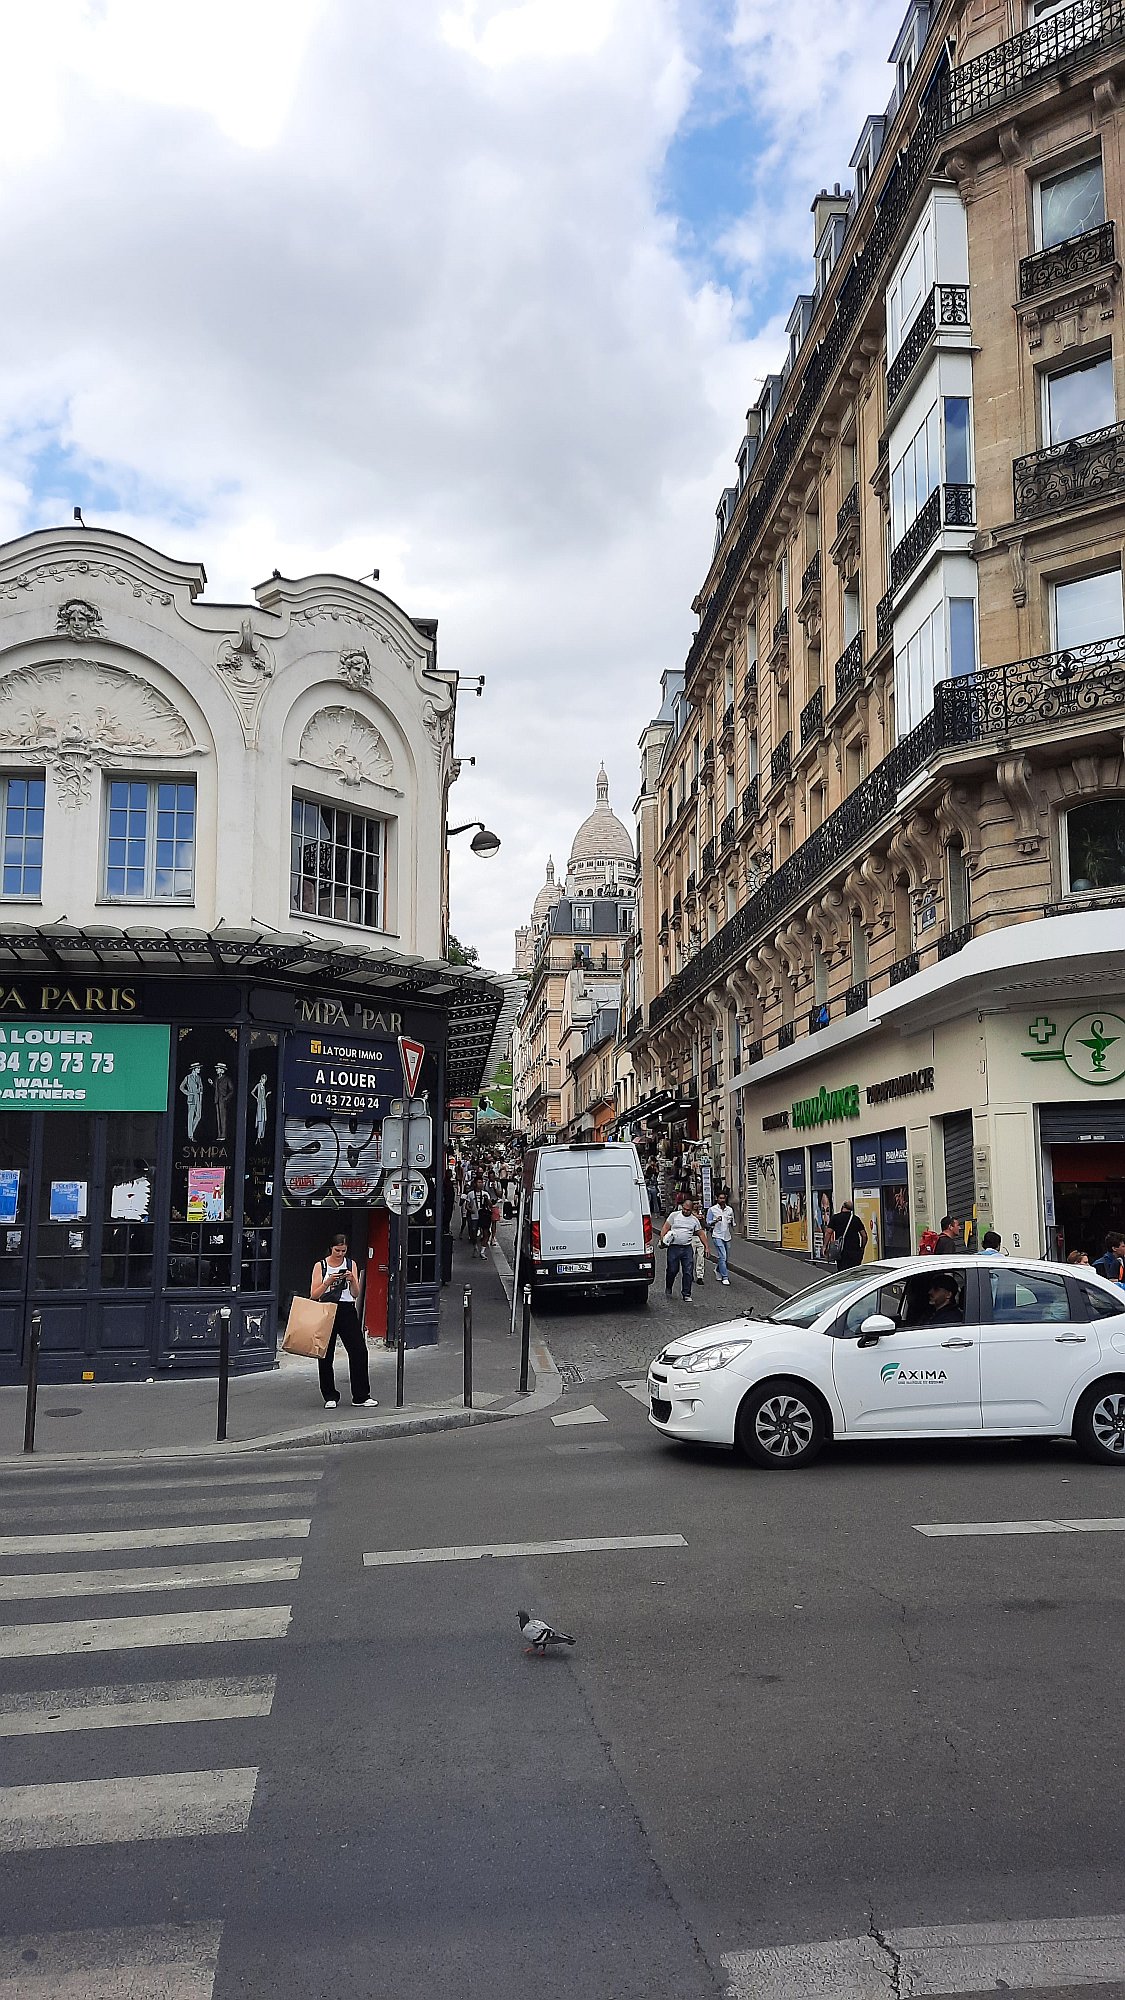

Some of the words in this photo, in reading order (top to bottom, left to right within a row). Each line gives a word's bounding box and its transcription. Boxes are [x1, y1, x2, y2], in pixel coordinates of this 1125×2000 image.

[40, 986, 137, 1011] PARIS
[295, 999, 350, 1028] MPA
[10, 1030, 93, 1045] LOUER
[334, 1047, 357, 1059] TOUR
[358, 1050, 383, 1061] IMMO
[28, 1051, 53, 1073] 79
[60, 1052, 84, 1073] 73
[91, 1052, 114, 1073] 73
[13, 1077, 64, 1088] WALL
[315, 1069, 326, 1085] A
[330, 1070, 377, 1089] LOUER
[0, 1089, 86, 1099] ARTNERS
[310, 1093, 323, 1105] 01
[325, 1094, 338, 1106] 43
[340, 1095, 352, 1107] 72
[353, 1096, 366, 1108] 04
[367, 1097, 380, 1109] 24
[182, 1145, 228, 1158] SYMPA
[897, 1370, 948, 1380] AXIMA
